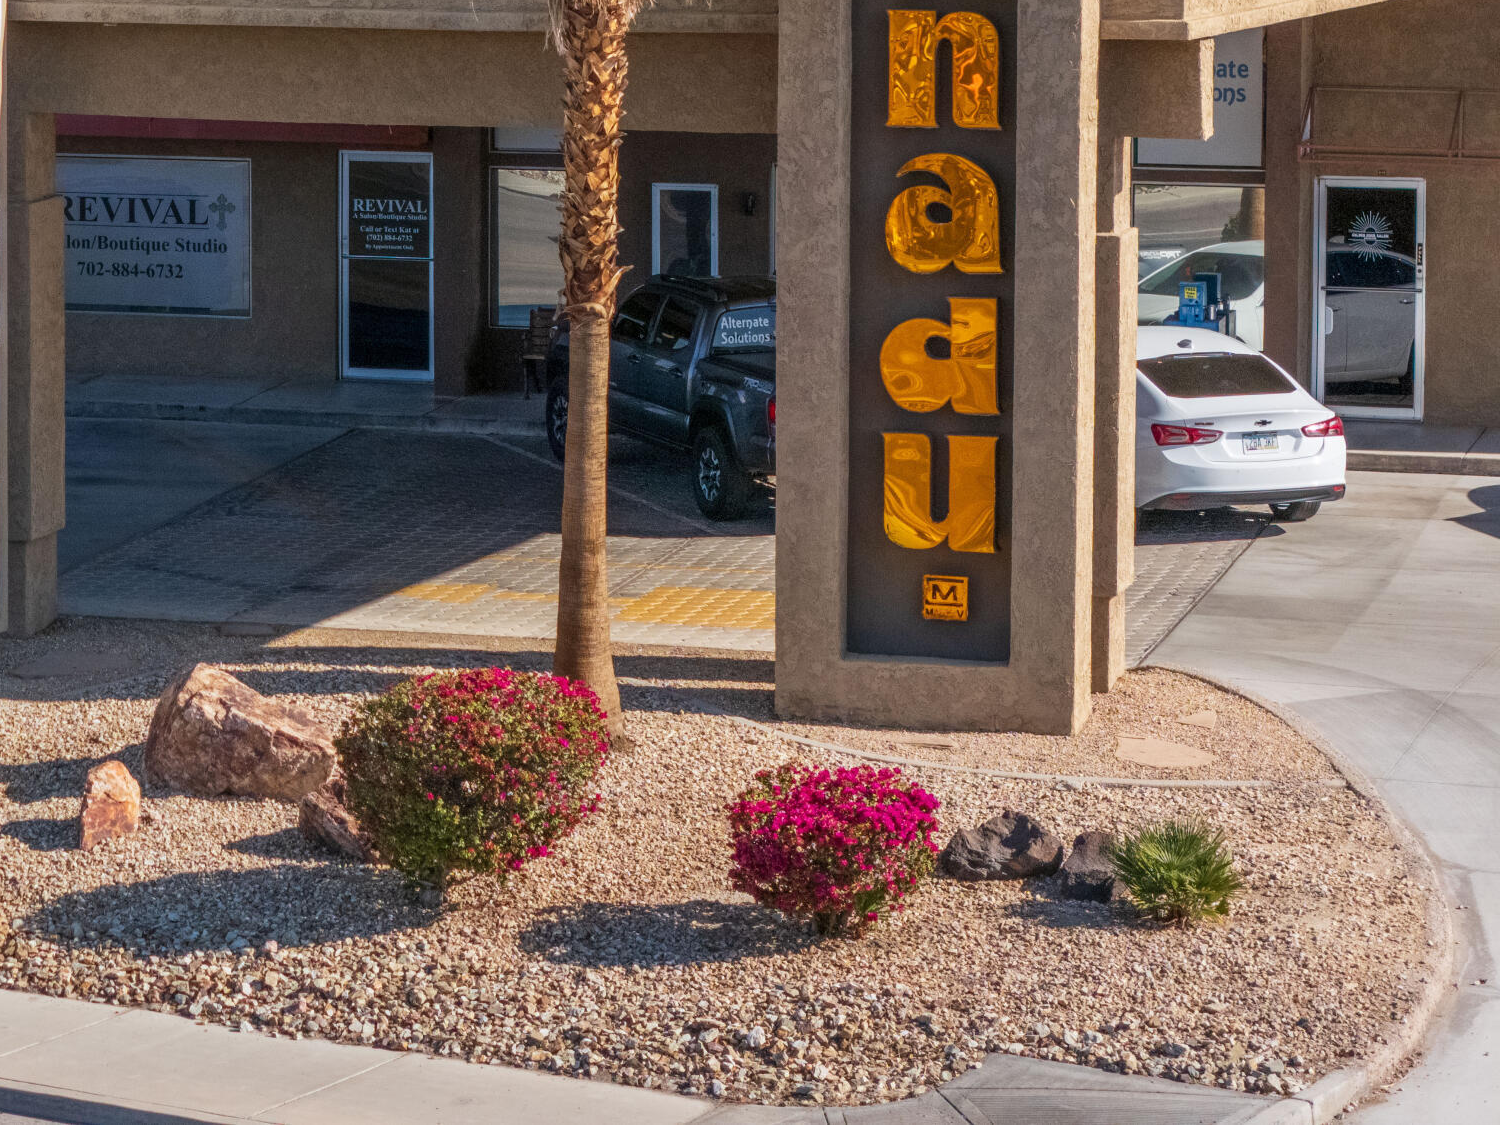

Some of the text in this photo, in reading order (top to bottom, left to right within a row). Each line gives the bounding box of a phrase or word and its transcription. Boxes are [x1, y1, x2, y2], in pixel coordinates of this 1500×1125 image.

[353, 198, 428, 214] REVIVAL
[66, 235, 228, 255] lon/Boutique Studio
[366, 234, 383, 242] (702)
[77, 261, 183, 279] 702-884-6732
[721, 316, 769, 329] Alternate
[721, 331, 771, 344] Solutions
